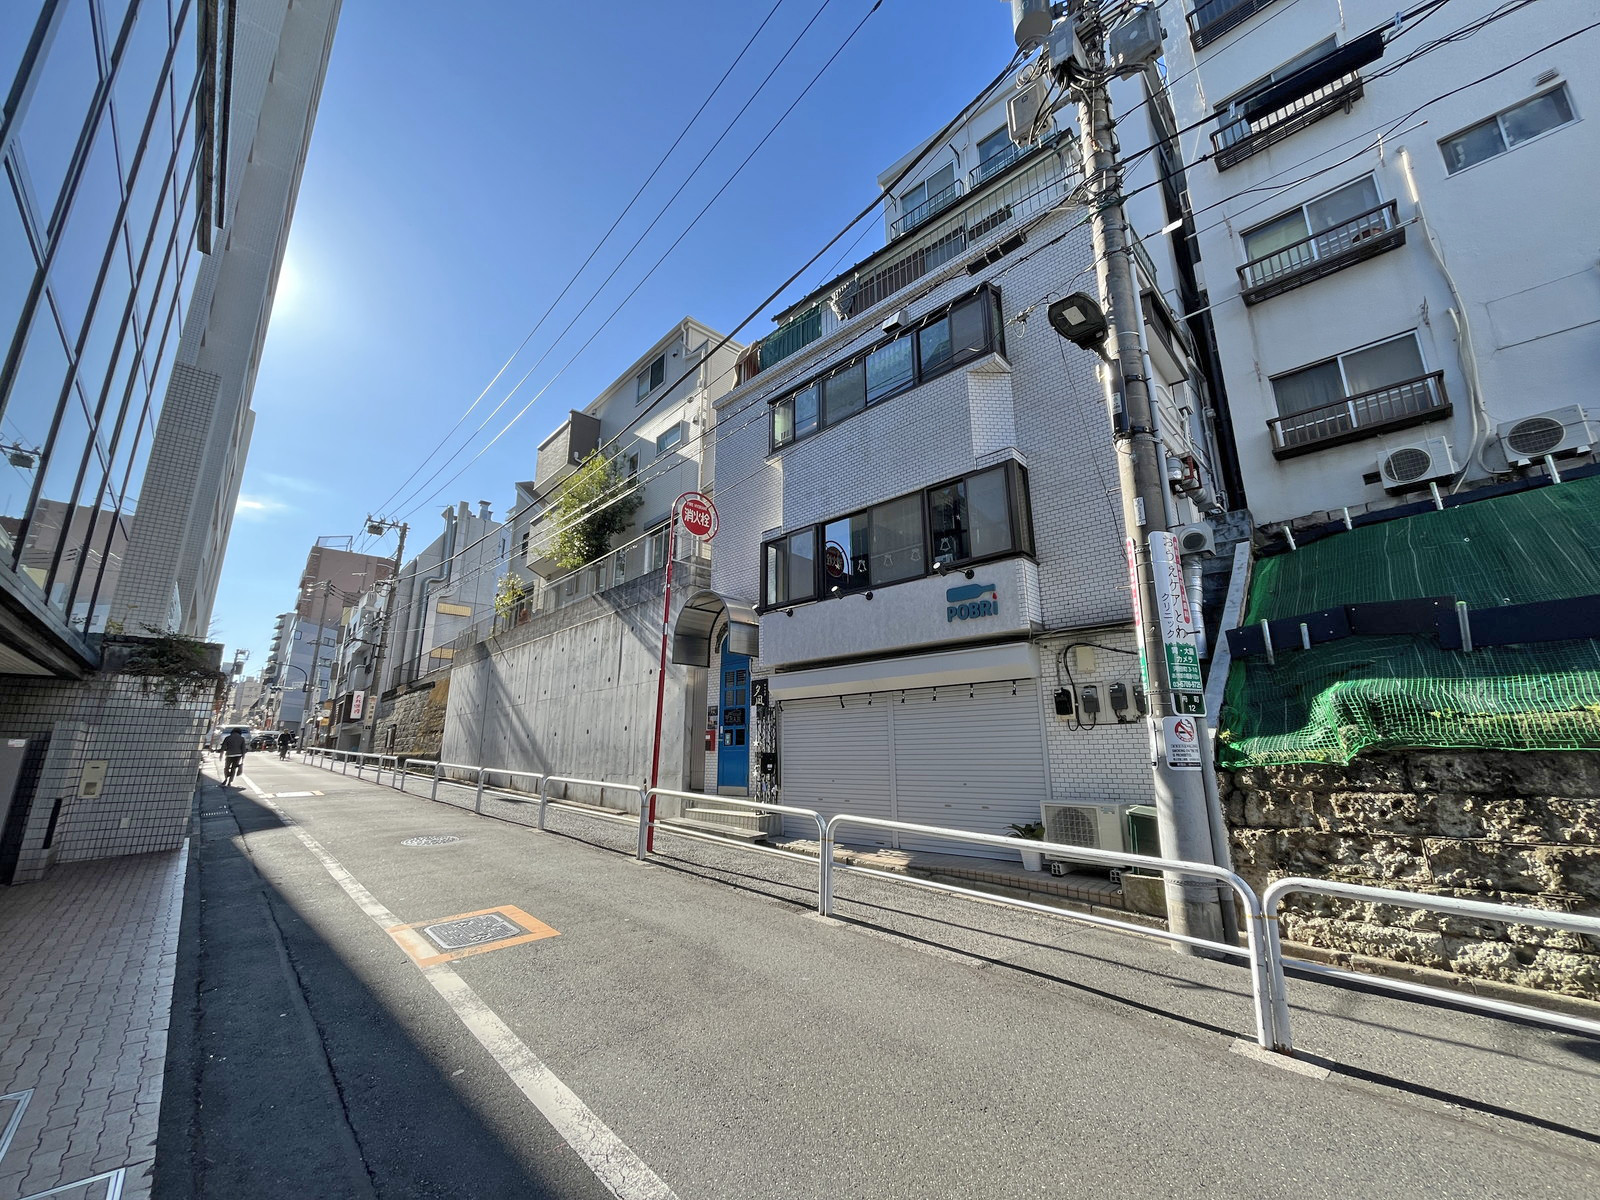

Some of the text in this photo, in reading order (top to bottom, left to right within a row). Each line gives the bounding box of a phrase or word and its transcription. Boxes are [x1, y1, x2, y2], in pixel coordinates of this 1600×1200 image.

[684, 507, 710, 527] 消火栓
[1161, 593, 1175, 638] クリニック
[1176, 656, 1193, 664] カメラ
[1188, 704, 1196, 712] 12
